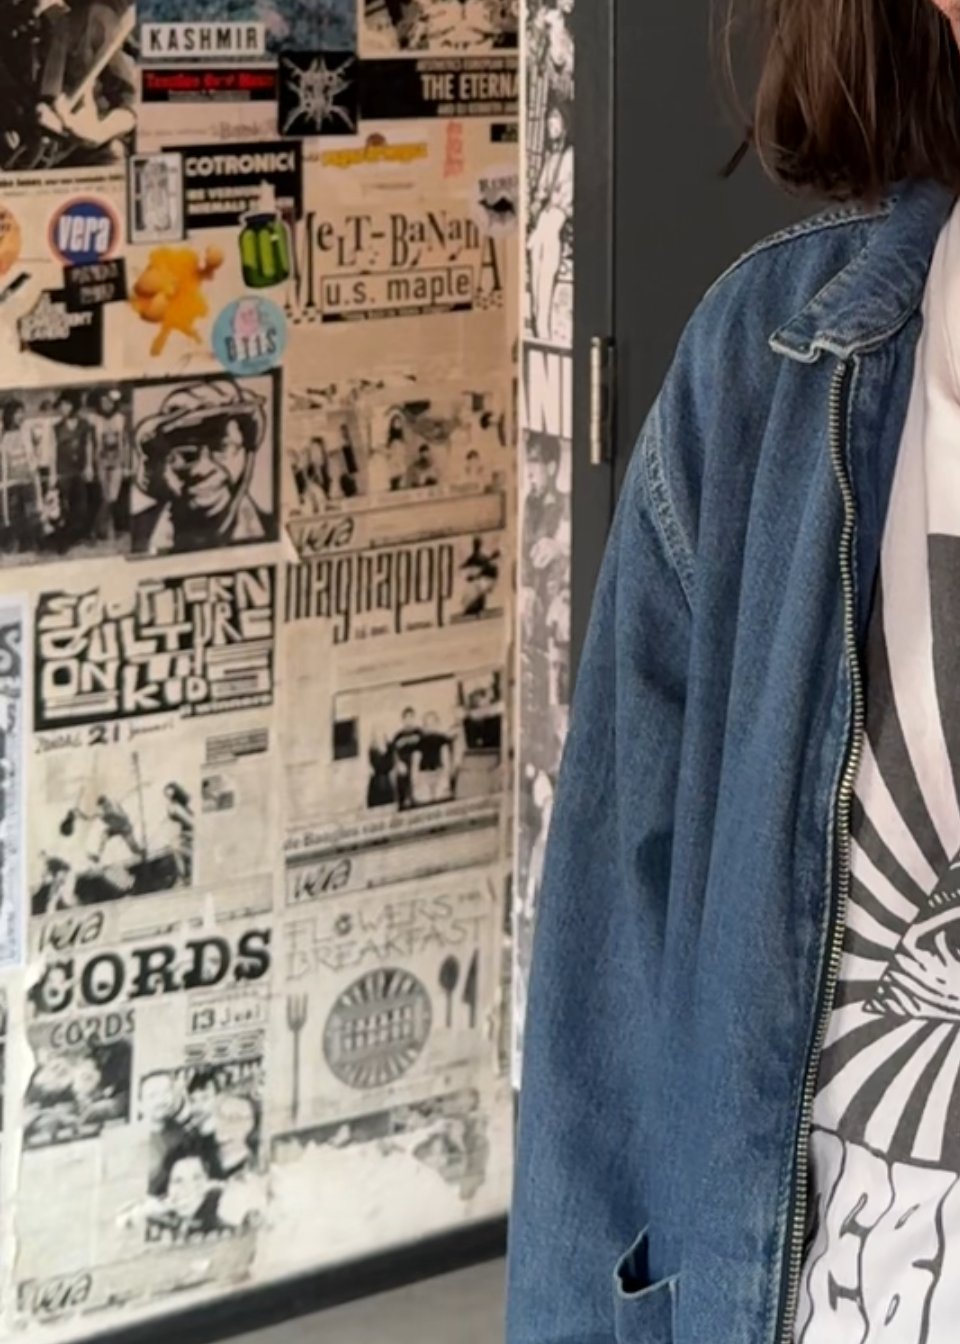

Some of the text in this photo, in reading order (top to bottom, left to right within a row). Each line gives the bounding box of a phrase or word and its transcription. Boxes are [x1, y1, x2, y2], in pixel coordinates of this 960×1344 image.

[149, 26, 260, 52] KASHMIR
[58, 214, 112, 254] vera
[386, 266, 472, 306] maple
[284, 543, 455, 645] magnapop
[88, 722, 120, 746] 21
[27, 927, 273, 1015] CORDS
[190, 1009, 216, 1032] 13
